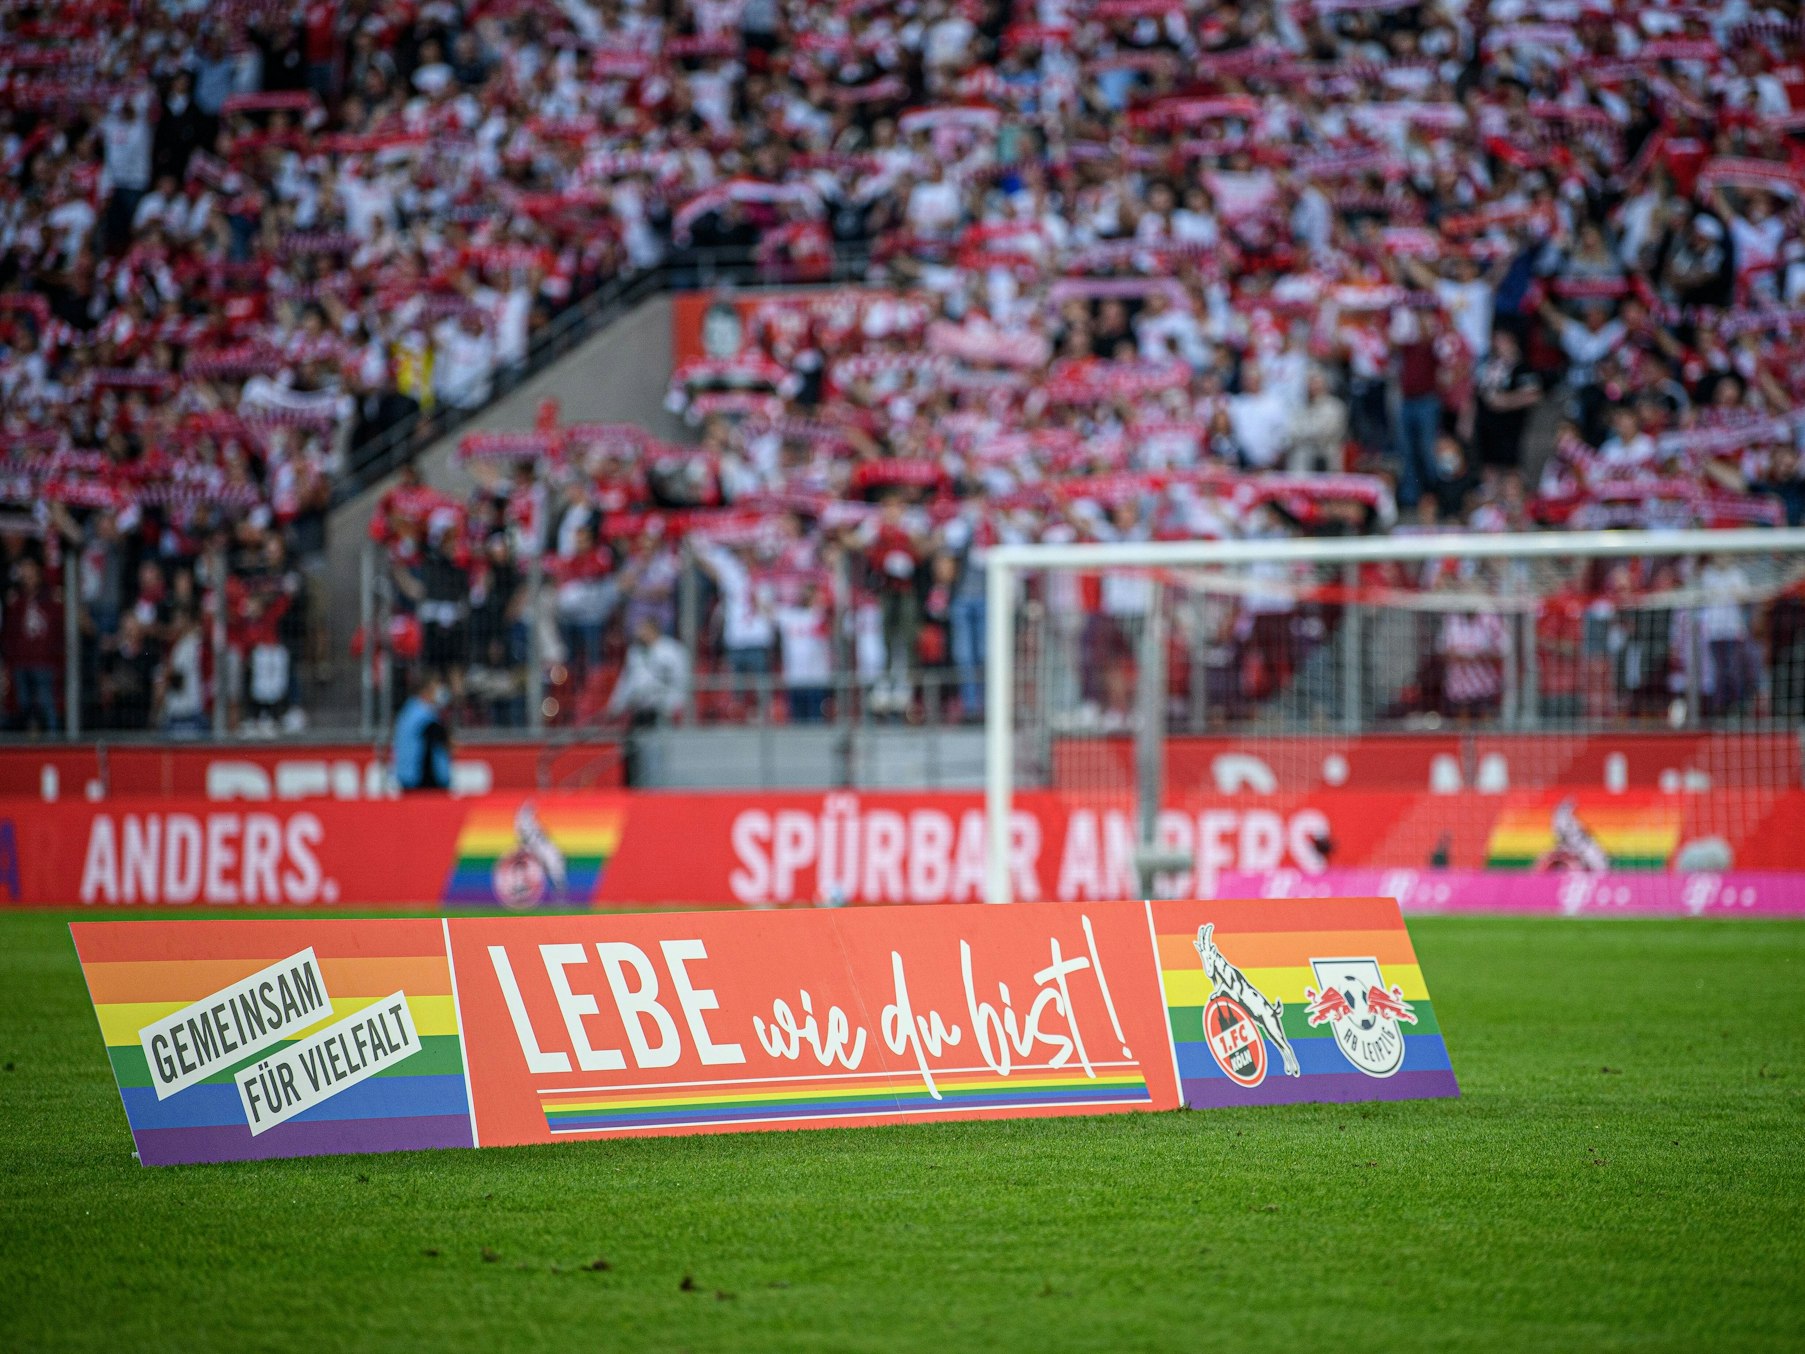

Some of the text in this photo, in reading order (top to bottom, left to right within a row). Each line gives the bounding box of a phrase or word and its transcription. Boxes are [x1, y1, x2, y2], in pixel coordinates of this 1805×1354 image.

[81, 812, 340, 903] ANDERS.
[729, 793, 1044, 903] SPÜRBAR
[151, 961, 323, 1084] GEMEINSAM
[244, 1004, 410, 1123] FÜR VIELFALT
[487, 939, 746, 1073] LEBE
[753, 989, 866, 1070] wie
[881, 951, 961, 1100] du
[1230, 1049, 1254, 1073] KÖLN
[1361, 1026, 1395, 1063] LEIPZIG
